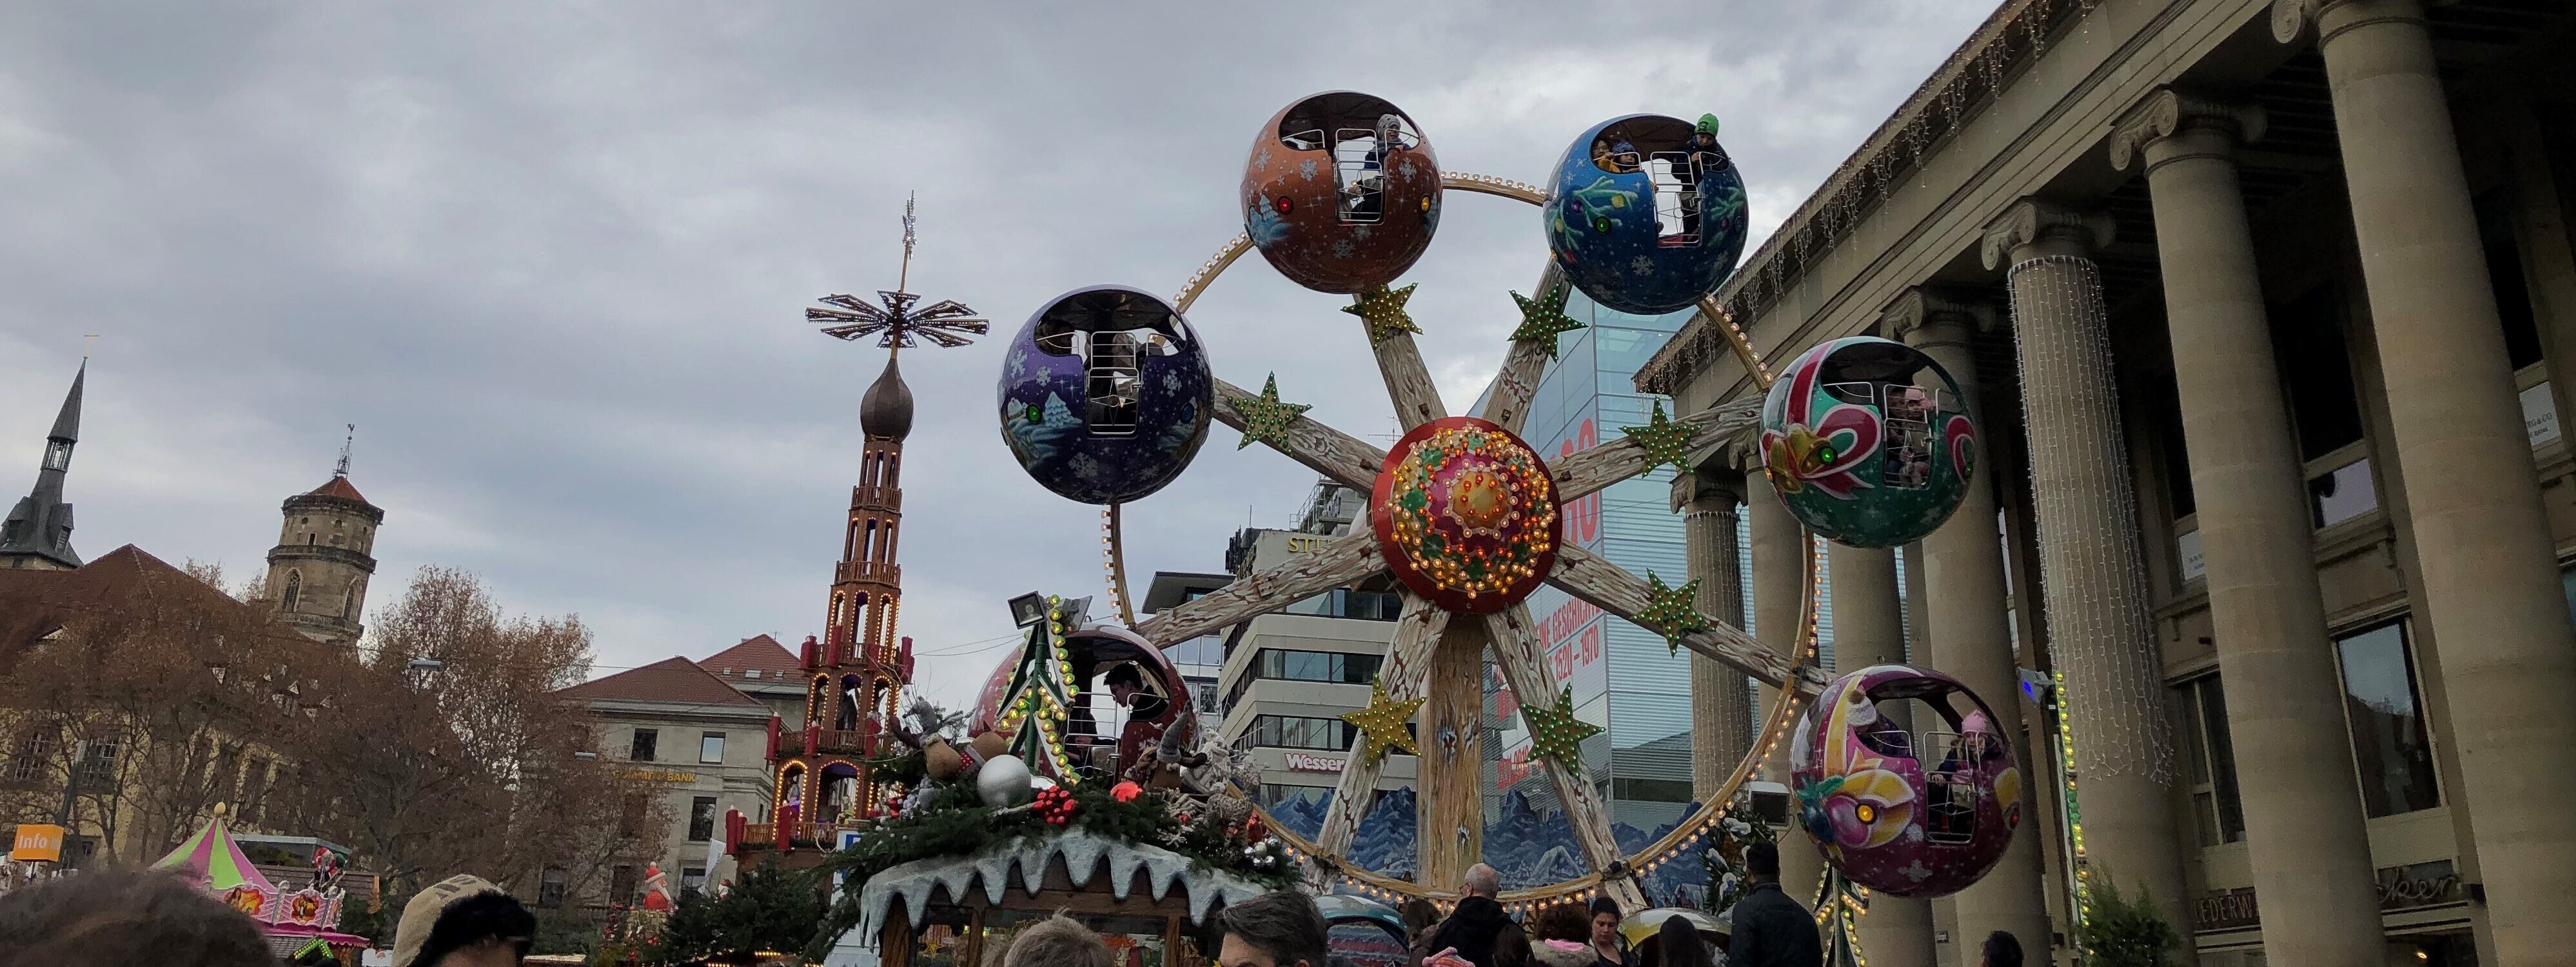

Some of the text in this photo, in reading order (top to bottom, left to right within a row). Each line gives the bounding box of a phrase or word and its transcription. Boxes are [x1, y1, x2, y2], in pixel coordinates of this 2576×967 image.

[1555, 643, 1572, 683] 1520
[1580, 624, 1598, 667] 1970
[18, 833, 48, 849] Info
